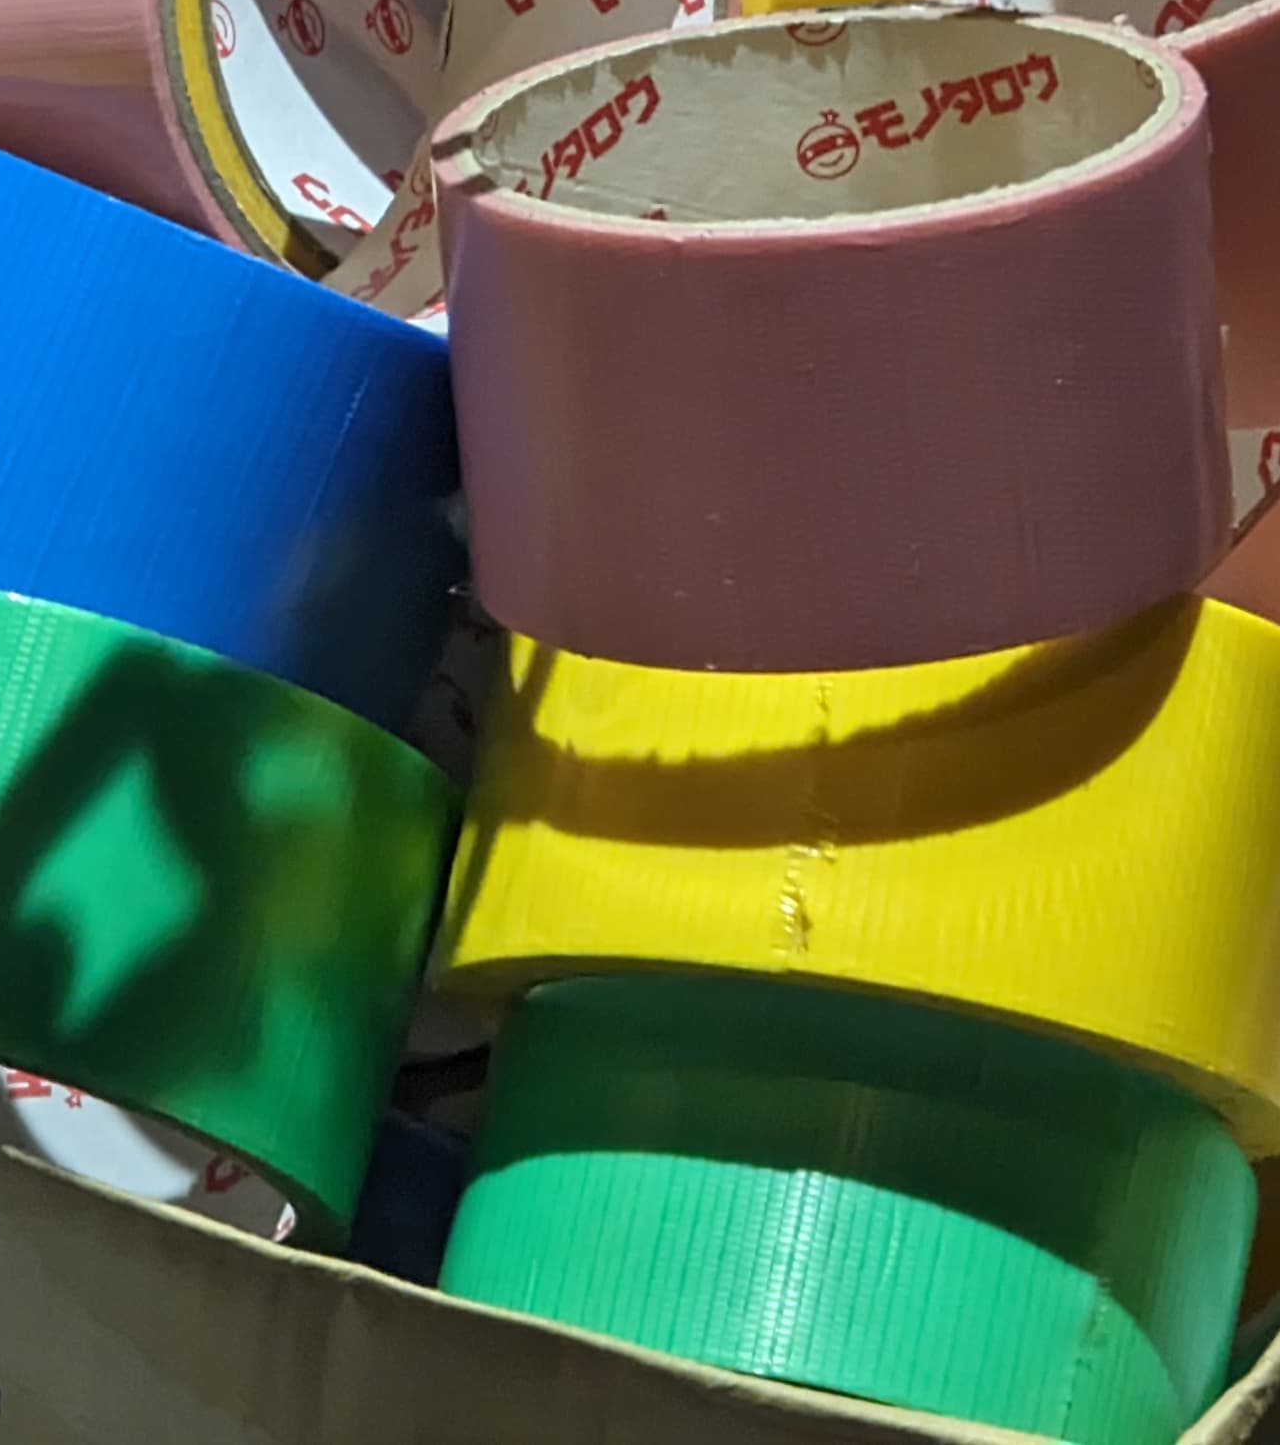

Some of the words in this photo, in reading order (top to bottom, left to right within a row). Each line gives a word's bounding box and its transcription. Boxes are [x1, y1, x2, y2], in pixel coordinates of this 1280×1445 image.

[515, 74, 662, 201] ノタロウ
[854, 53, 1060, 149] モノタロウ
